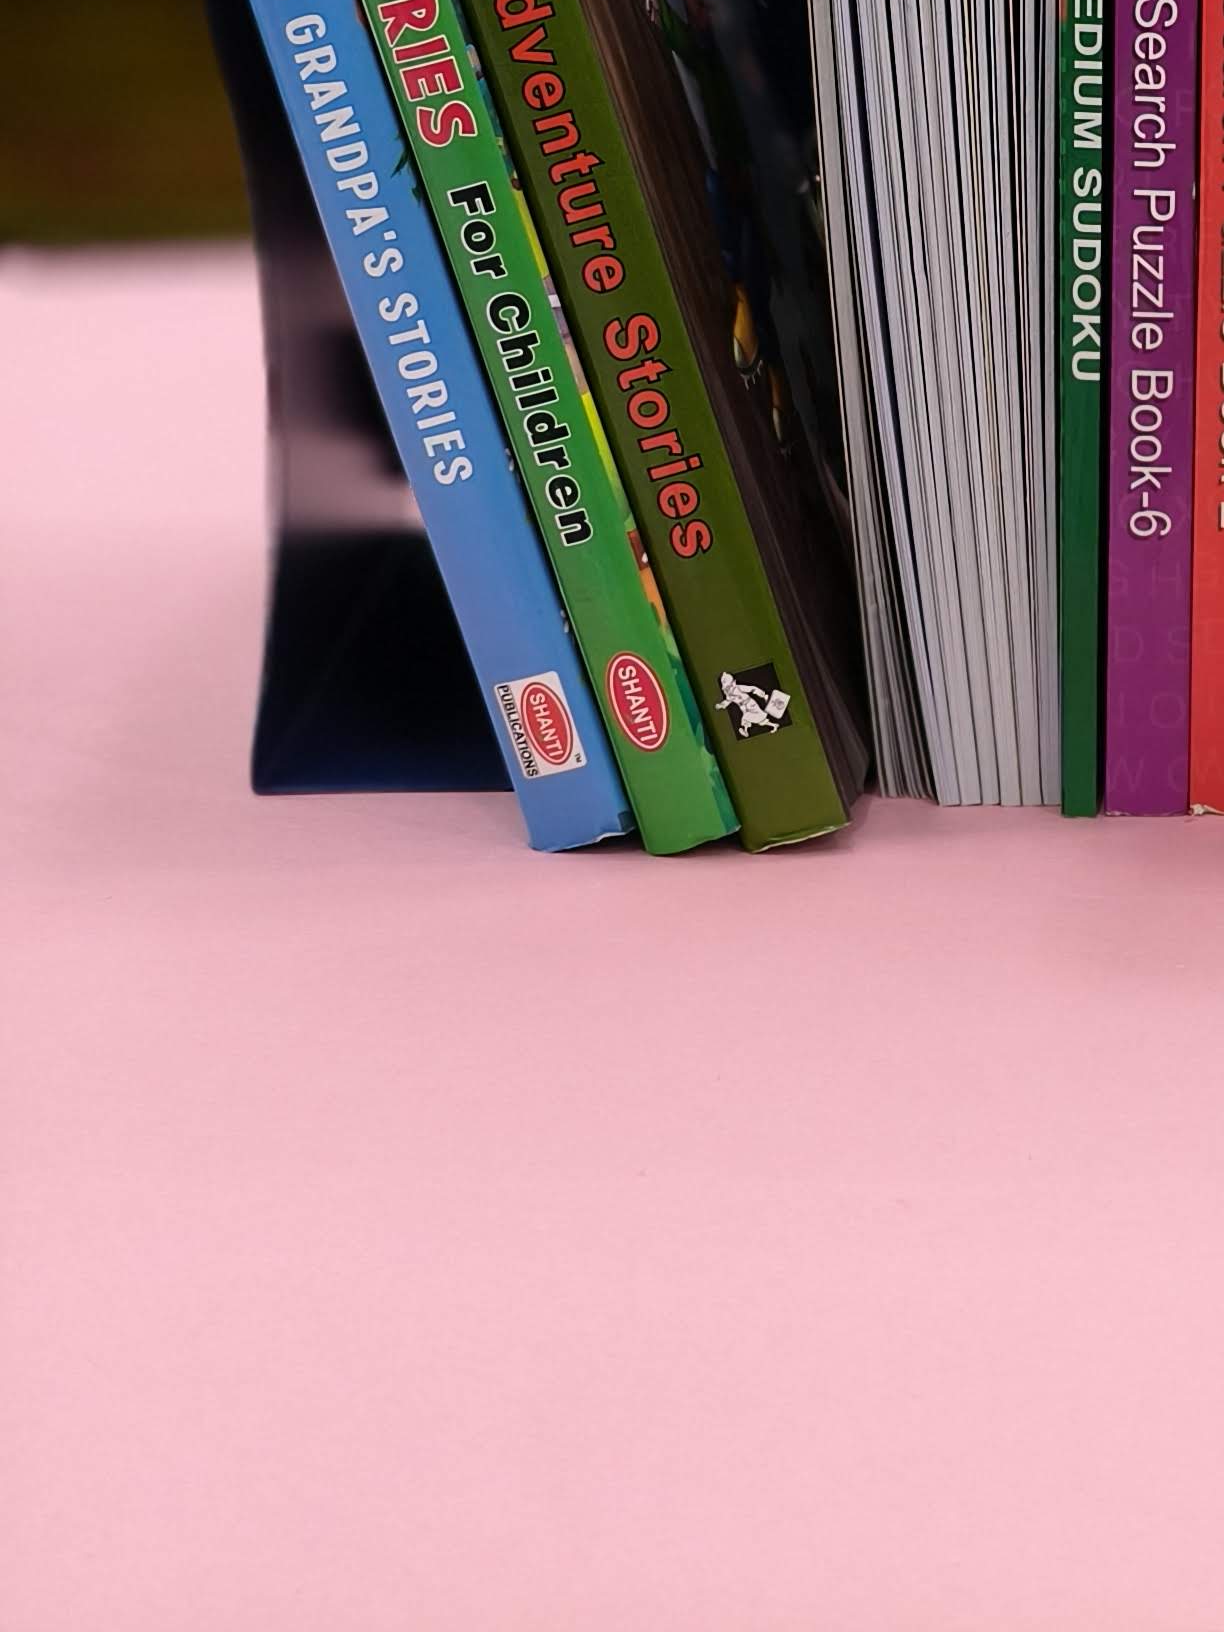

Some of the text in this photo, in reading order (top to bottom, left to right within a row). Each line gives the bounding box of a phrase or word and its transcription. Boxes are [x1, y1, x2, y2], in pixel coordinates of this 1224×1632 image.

[285, 14, 403, 279] GRANDPA'S
[378, 293, 473, 487] STORIES
[1070, 166, 1103, 383] SUDOKU
[1130, 188, 1176, 352] Puzzle
[446, 180, 595, 547] For Children
[604, 312, 715, 560] Stories
[1127, 370, 1174, 538] Book-6
[497, 685, 538, 778] PUBLICATIONS
[529, 692, 564, 758] SHANTI
[618, 665, 659, 742] SHANTI
